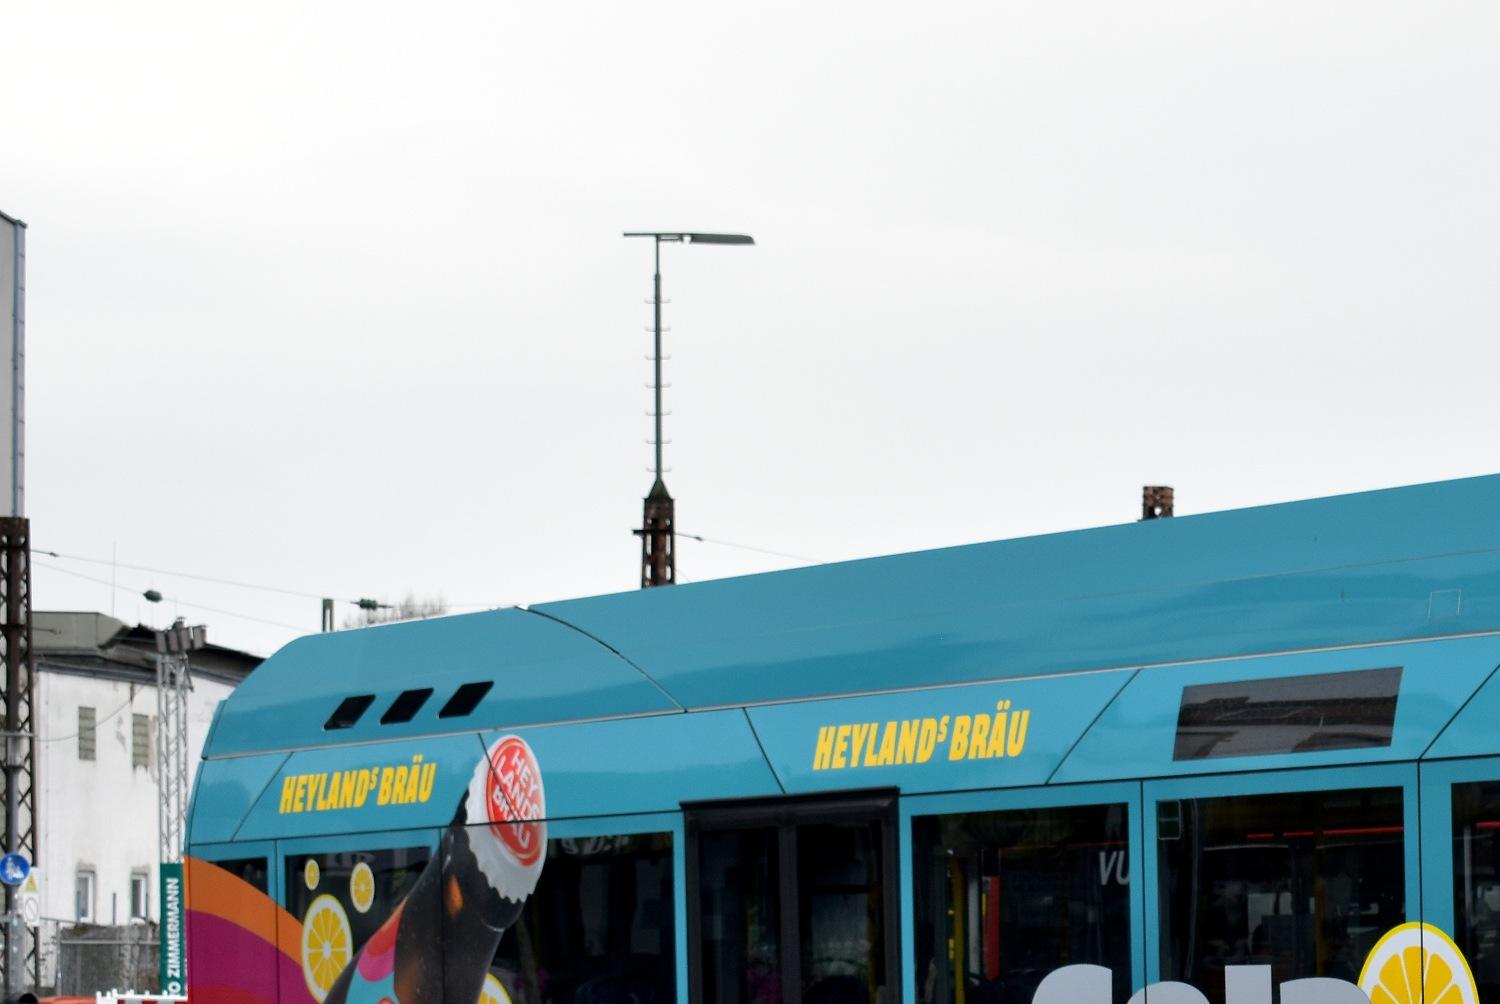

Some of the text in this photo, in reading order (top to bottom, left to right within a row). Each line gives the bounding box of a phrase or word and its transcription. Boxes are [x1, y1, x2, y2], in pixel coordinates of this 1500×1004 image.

[948, 700, 1031, 760] BRÄU
[377, 754, 437, 806] BRÄU
[166, 877, 181, 978] ZIMMERMANN
